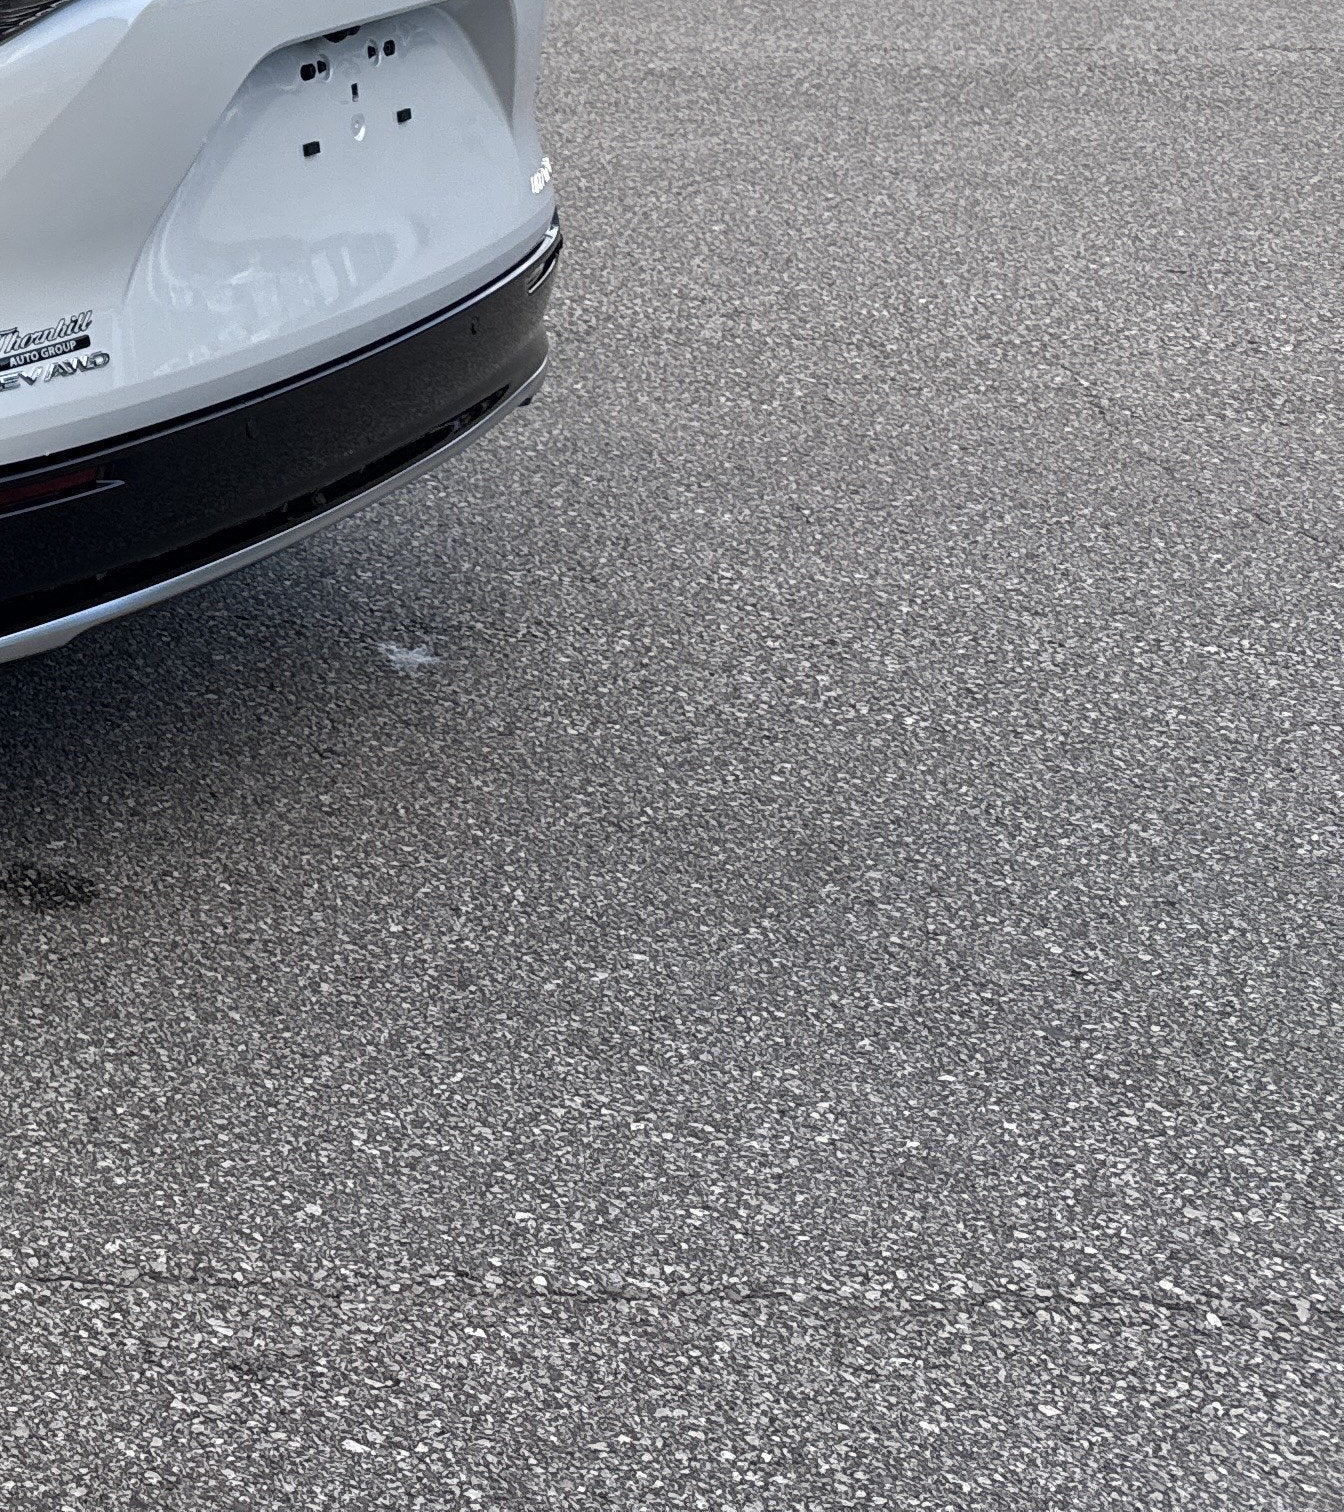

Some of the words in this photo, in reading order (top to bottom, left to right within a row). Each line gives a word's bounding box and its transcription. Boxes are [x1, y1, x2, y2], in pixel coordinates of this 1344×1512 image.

[9, 351, 40, 368] AUTO
[40, 340, 77, 358] GROUP
[44, 351, 110, 382] AWD
